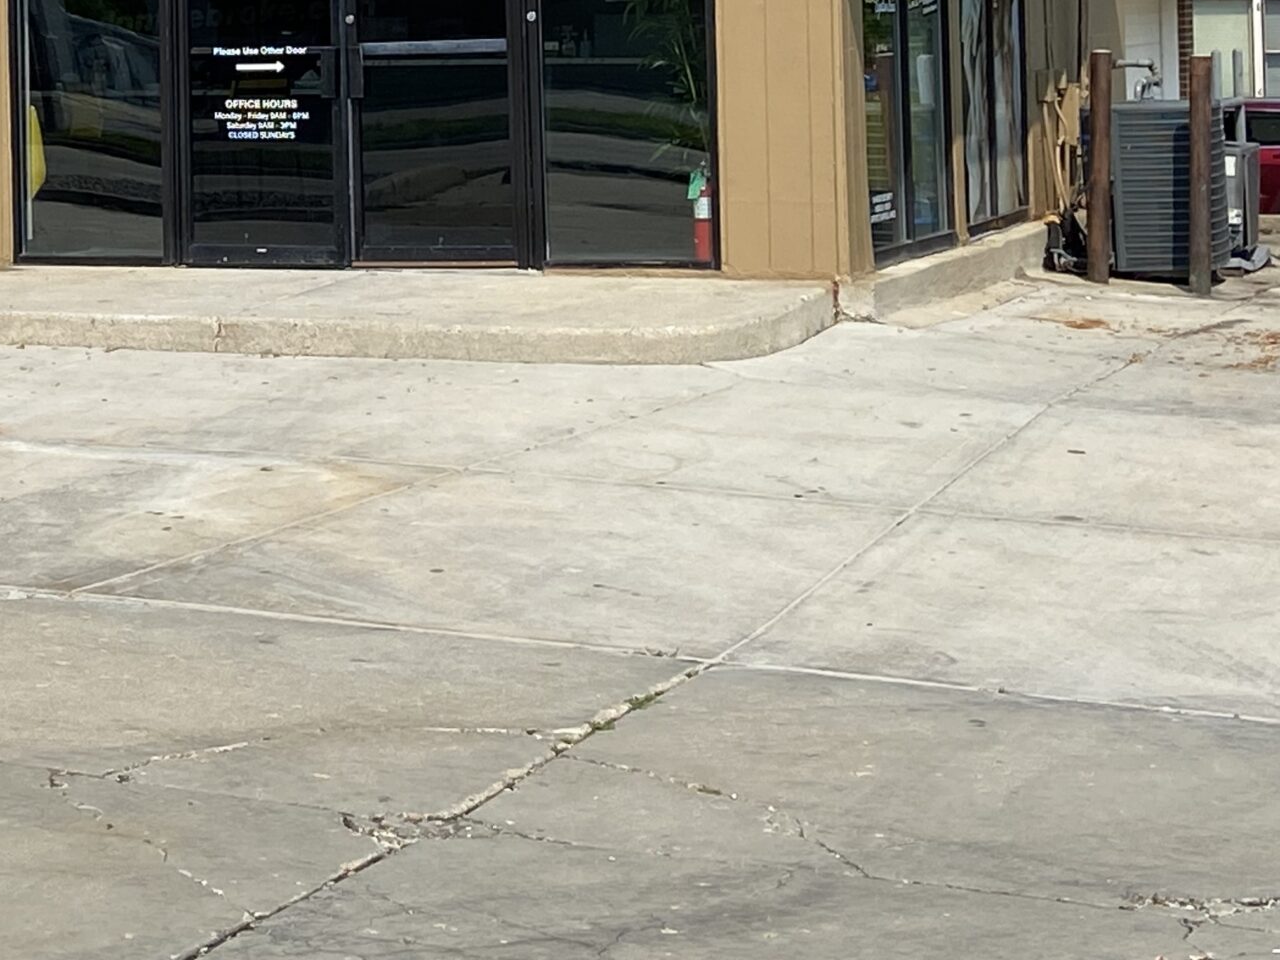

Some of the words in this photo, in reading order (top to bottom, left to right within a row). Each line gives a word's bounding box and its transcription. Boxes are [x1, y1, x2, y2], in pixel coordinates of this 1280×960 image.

[213, 47, 241, 56] Please
[242, 47, 259, 55] Use
[260, 46, 284, 55] Other
[286, 46, 307, 54] Door
[225, 99, 261, 109] OFFICE
[262, 99, 298, 109] HOURS
